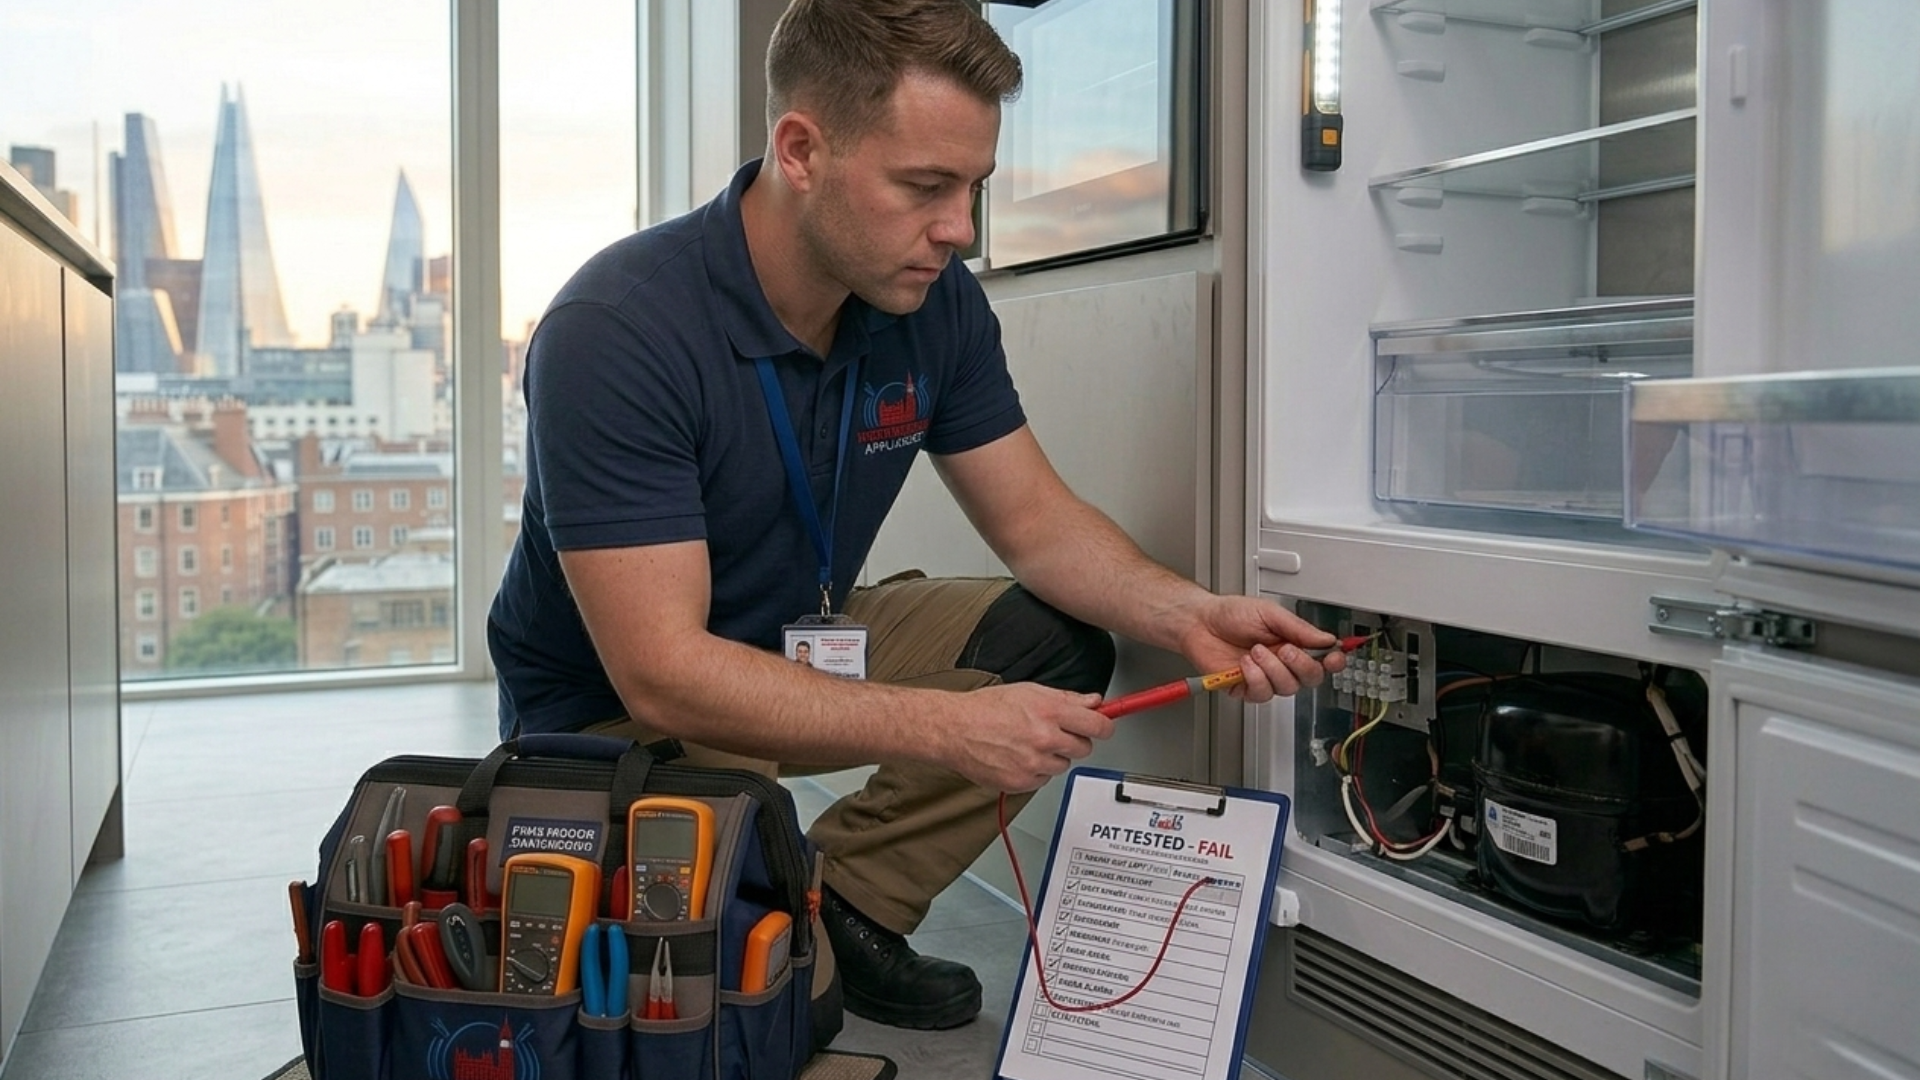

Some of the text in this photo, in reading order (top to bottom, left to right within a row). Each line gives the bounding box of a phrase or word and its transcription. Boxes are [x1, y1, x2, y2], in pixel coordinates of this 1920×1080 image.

[1090, 823, 1122, 840] PAT
[1123, 828, 1185, 851] TESTED
[1197, 840, 1234, 860] FAIL
